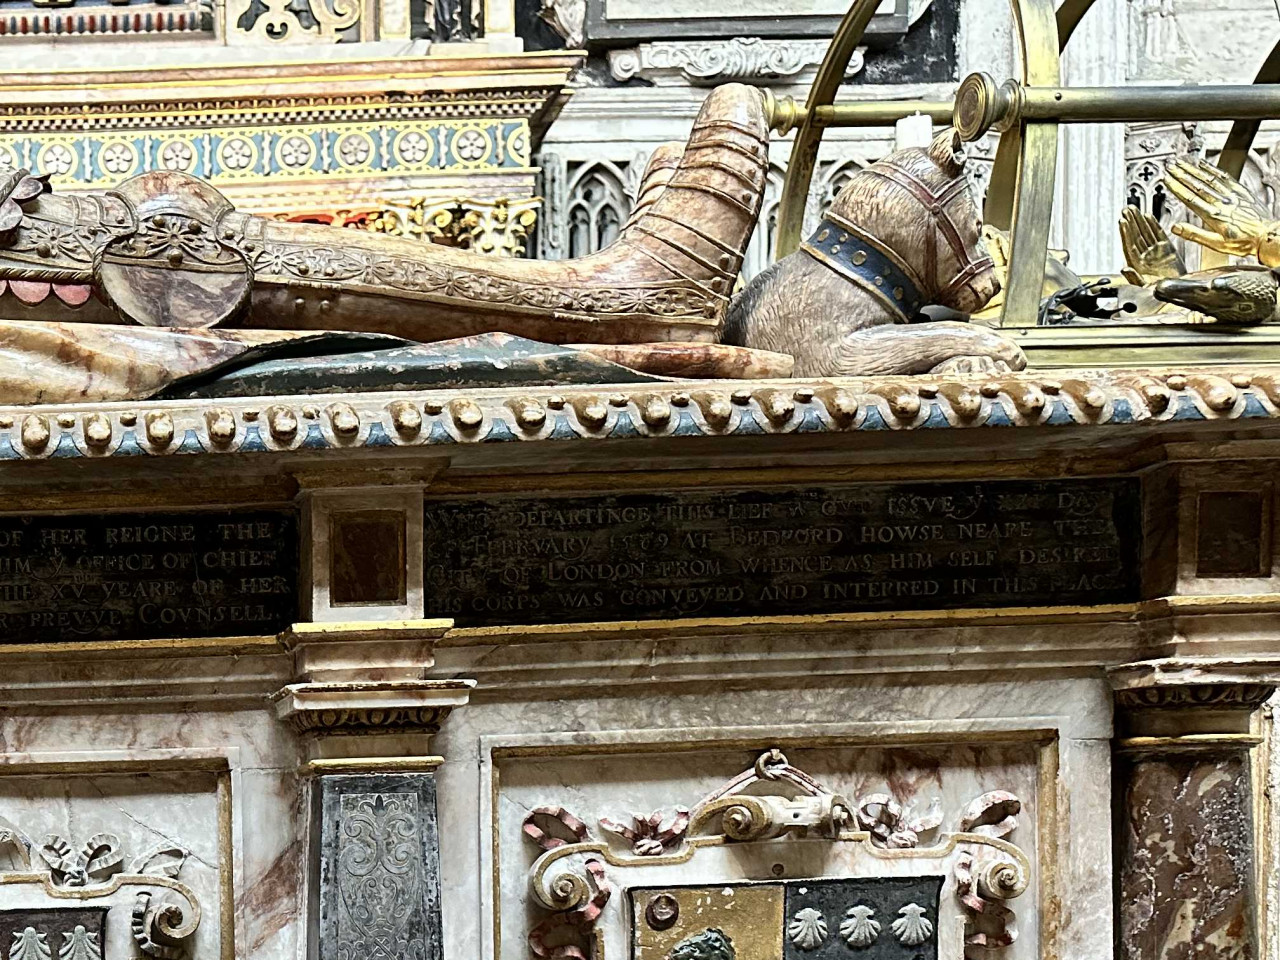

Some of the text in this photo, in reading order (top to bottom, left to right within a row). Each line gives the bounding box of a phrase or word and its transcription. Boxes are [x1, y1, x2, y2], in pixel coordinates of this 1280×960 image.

[41, 525, 87, 546] HER
[105, 524, 196, 544] REIGNE
[217, 521, 272, 541] THE
[682, 530, 712, 550] AT
[860, 523, 944, 543] HOWSE
[162, 550, 193, 569] OF
[202, 547, 277, 568] CHIEF
[547, 561, 646, 582] LONDON
[659, 559, 721, 578] FROM
[738, 554, 833, 574] WHENCE
[843, 553, 872, 572] AS
[891, 551, 934, 570] HIM
[947, 549, 998, 568] SELF
[192, 578, 224, 597] OF
[239, 574, 291, 595] HER
[471, 594, 542, 613] CORPS
[558, 591, 605, 609] WAS
[759, 583, 808, 602] AND
[952, 577, 977, 596] IN
